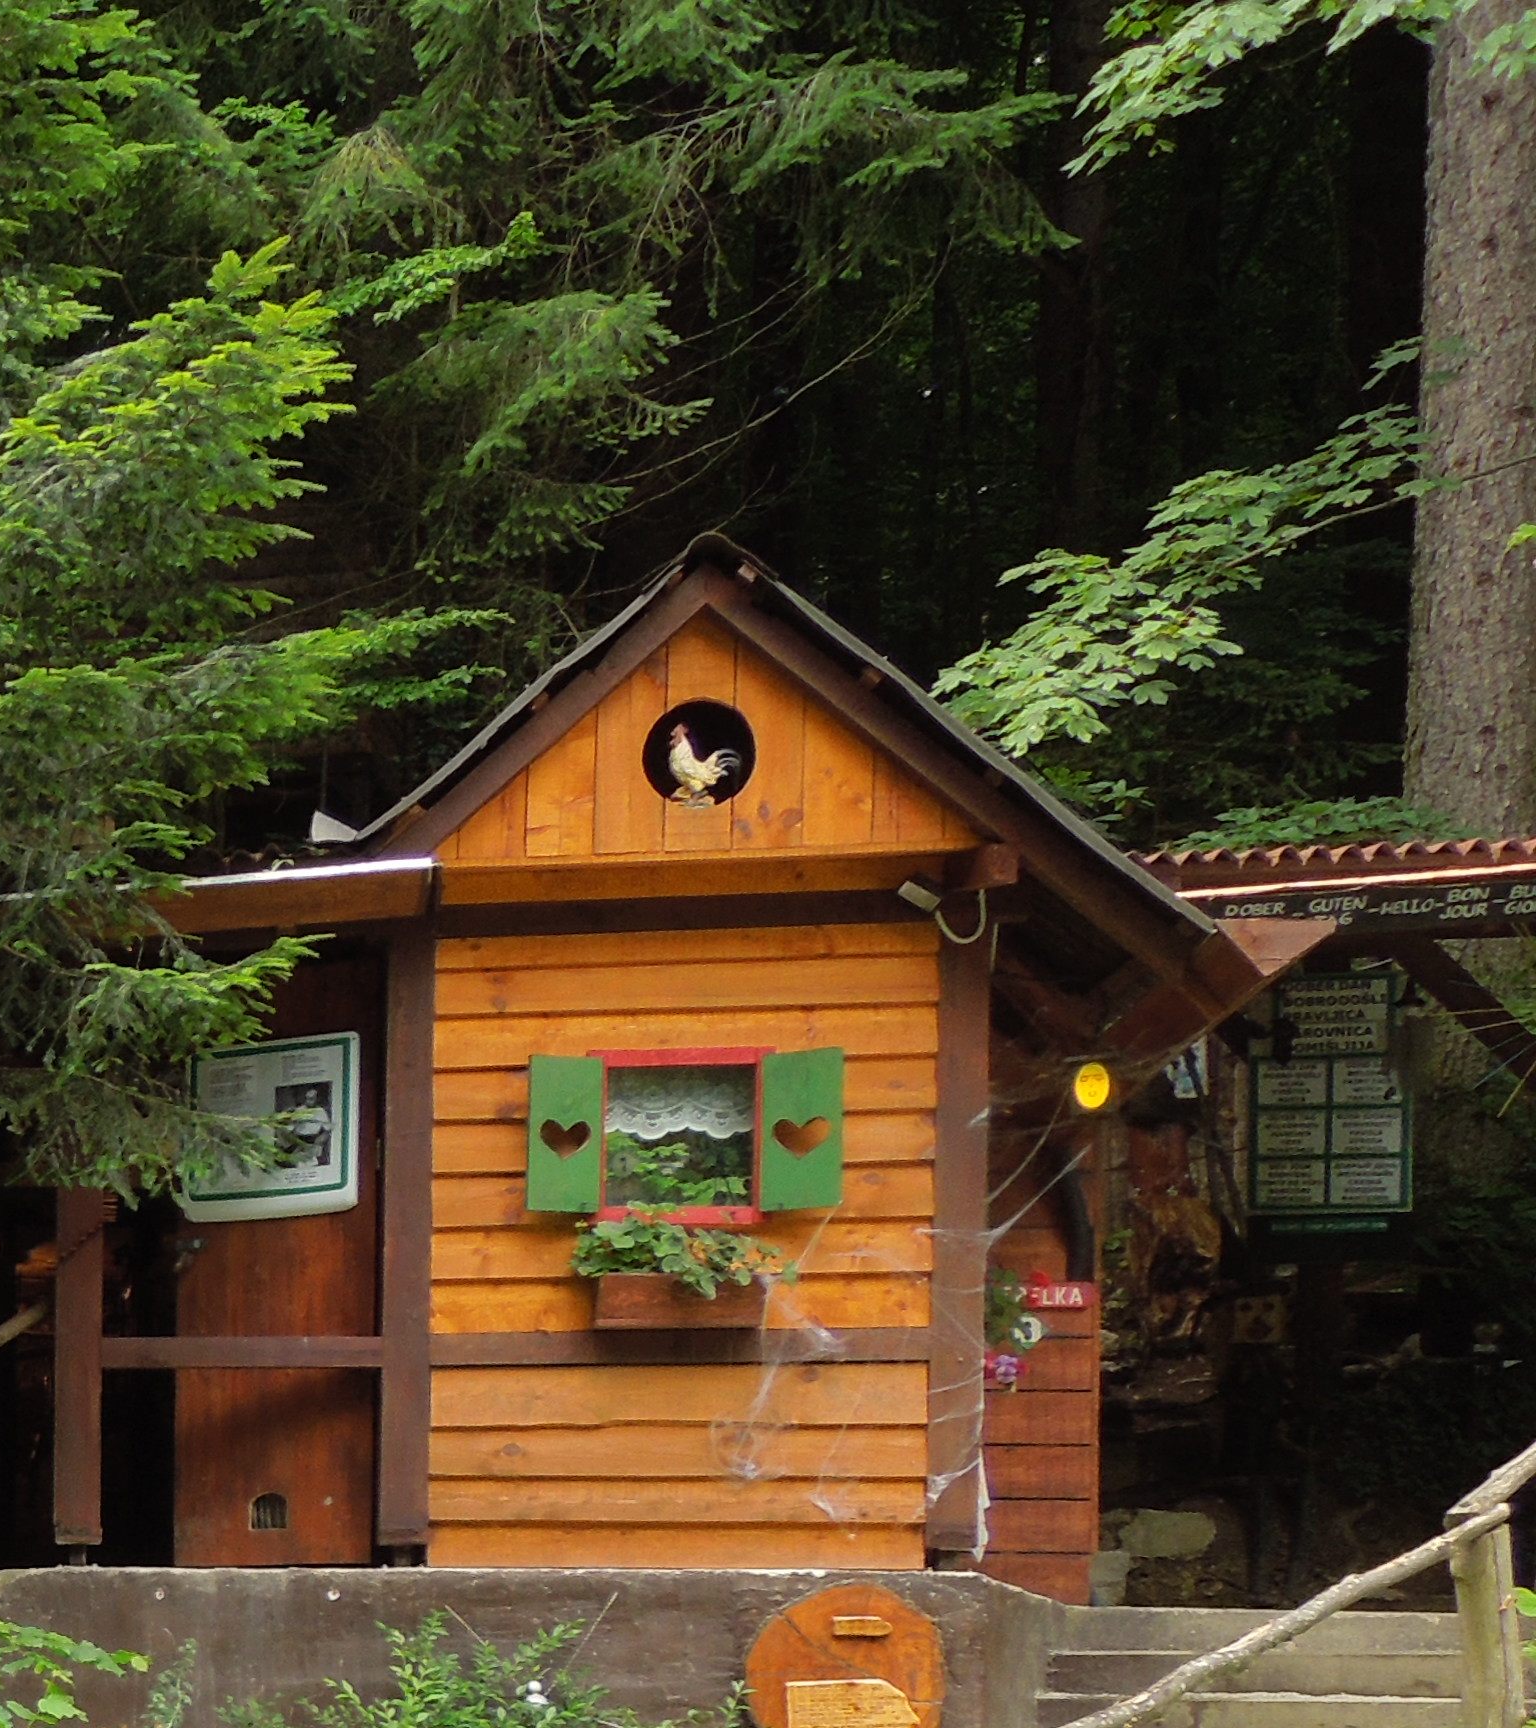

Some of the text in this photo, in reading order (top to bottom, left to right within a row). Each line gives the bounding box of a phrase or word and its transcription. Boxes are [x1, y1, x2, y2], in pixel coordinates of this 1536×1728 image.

[1446, 886, 1491, 903] BON
[1224, 902, 1286, 917] DOBER
[1308, 895, 1368, 914] GUTEN
[1439, 902, 1488, 920] JOUR
[1504, 899, 1536, 915] GIO
